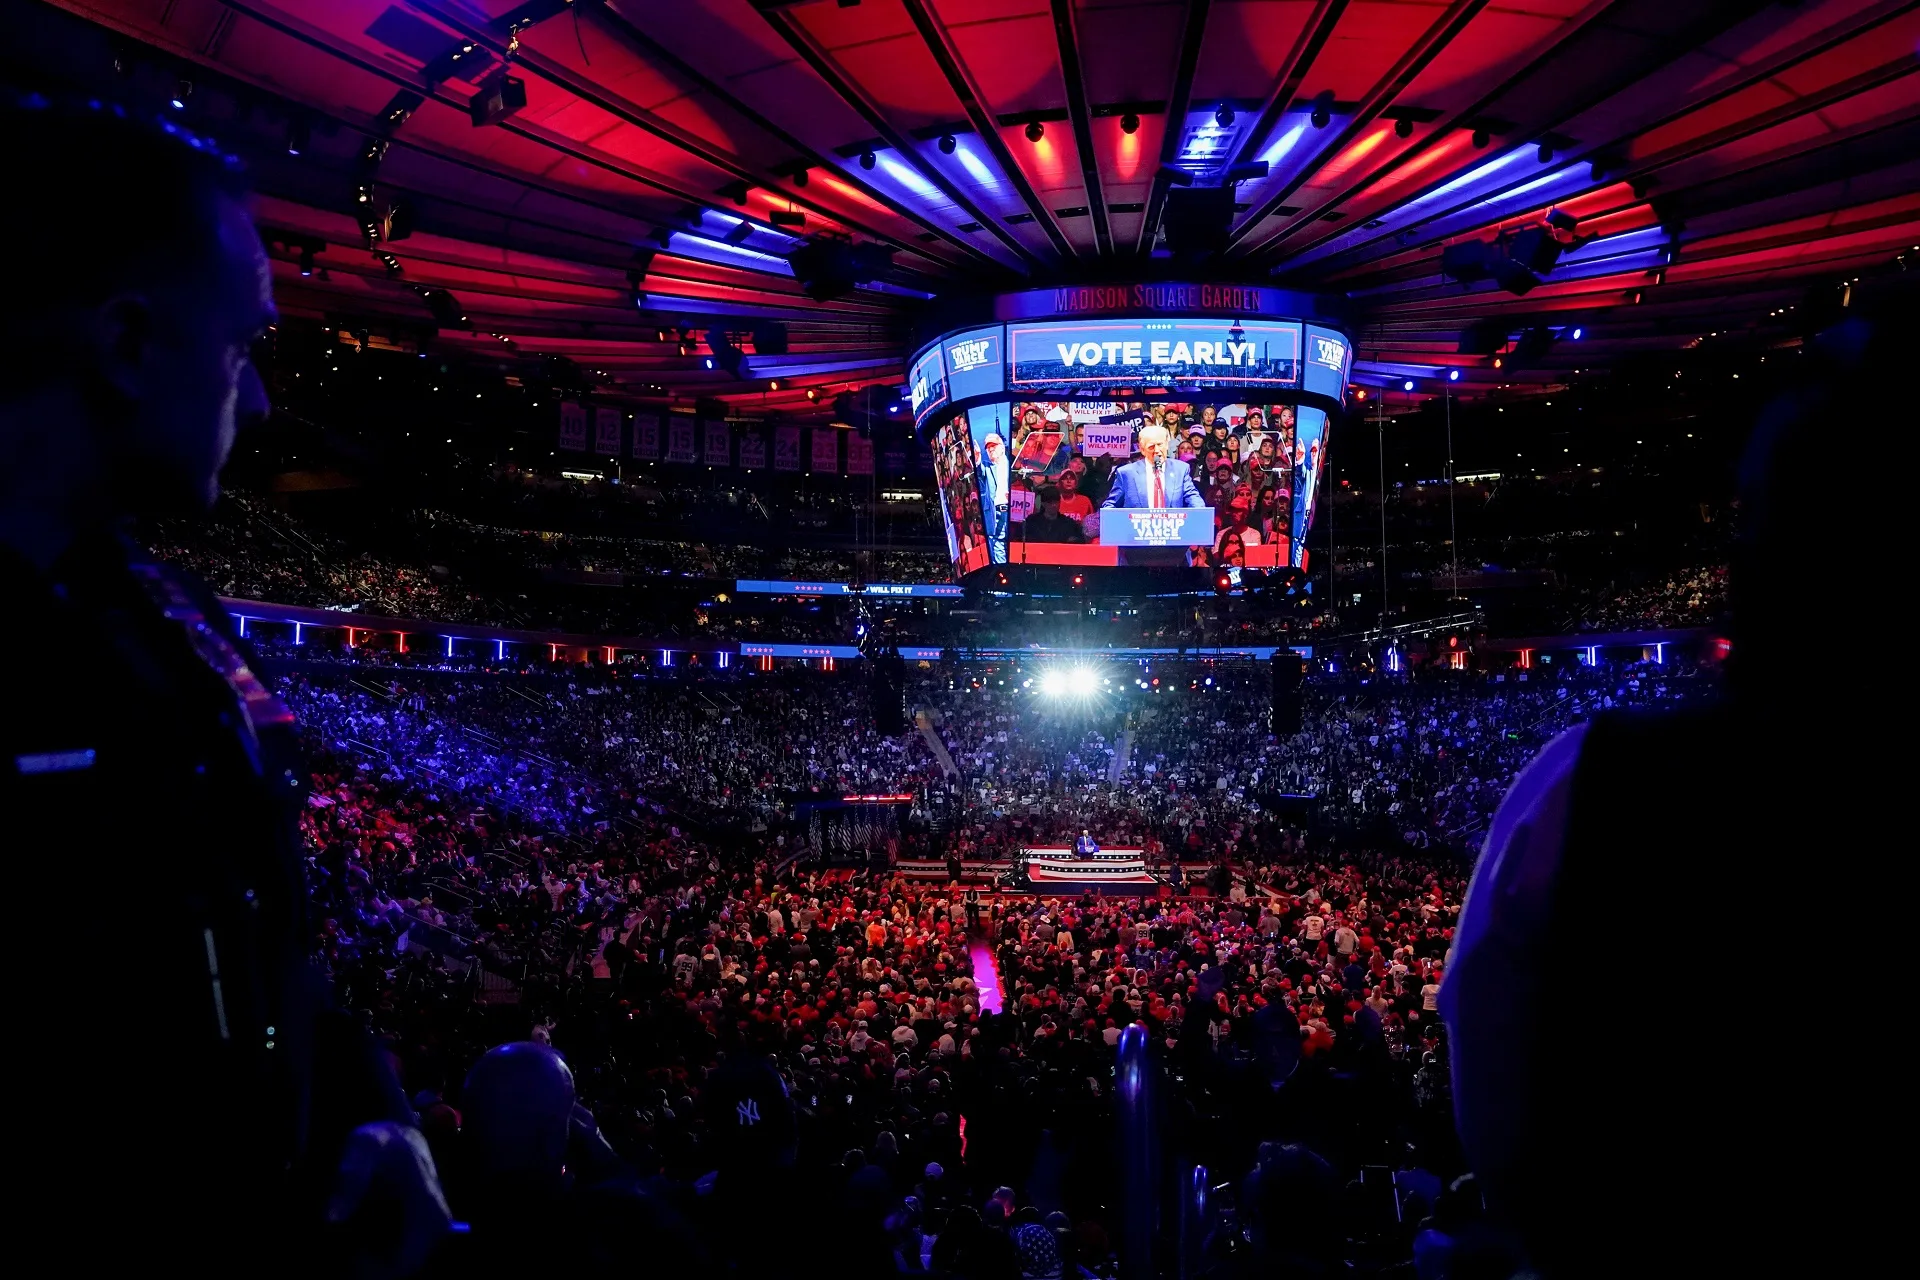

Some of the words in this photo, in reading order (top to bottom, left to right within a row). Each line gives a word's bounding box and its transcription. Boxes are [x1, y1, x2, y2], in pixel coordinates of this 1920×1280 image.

[1054, 287, 1128, 312] MADISON
[1133, 284, 1198, 309] SQUARE
[1201, 284, 1261, 310] GARDEN
[1057, 341, 1142, 366] VOTE
[1150, 341, 1257, 366] EARLY!
[1087, 434, 1127, 443] TRUMP
[1130, 518, 1185, 529] TRUMP
[1136, 528, 1179, 537] VANCE
[681, 961, 693, 972] 99
[736, 1098, 761, 1126] NY
